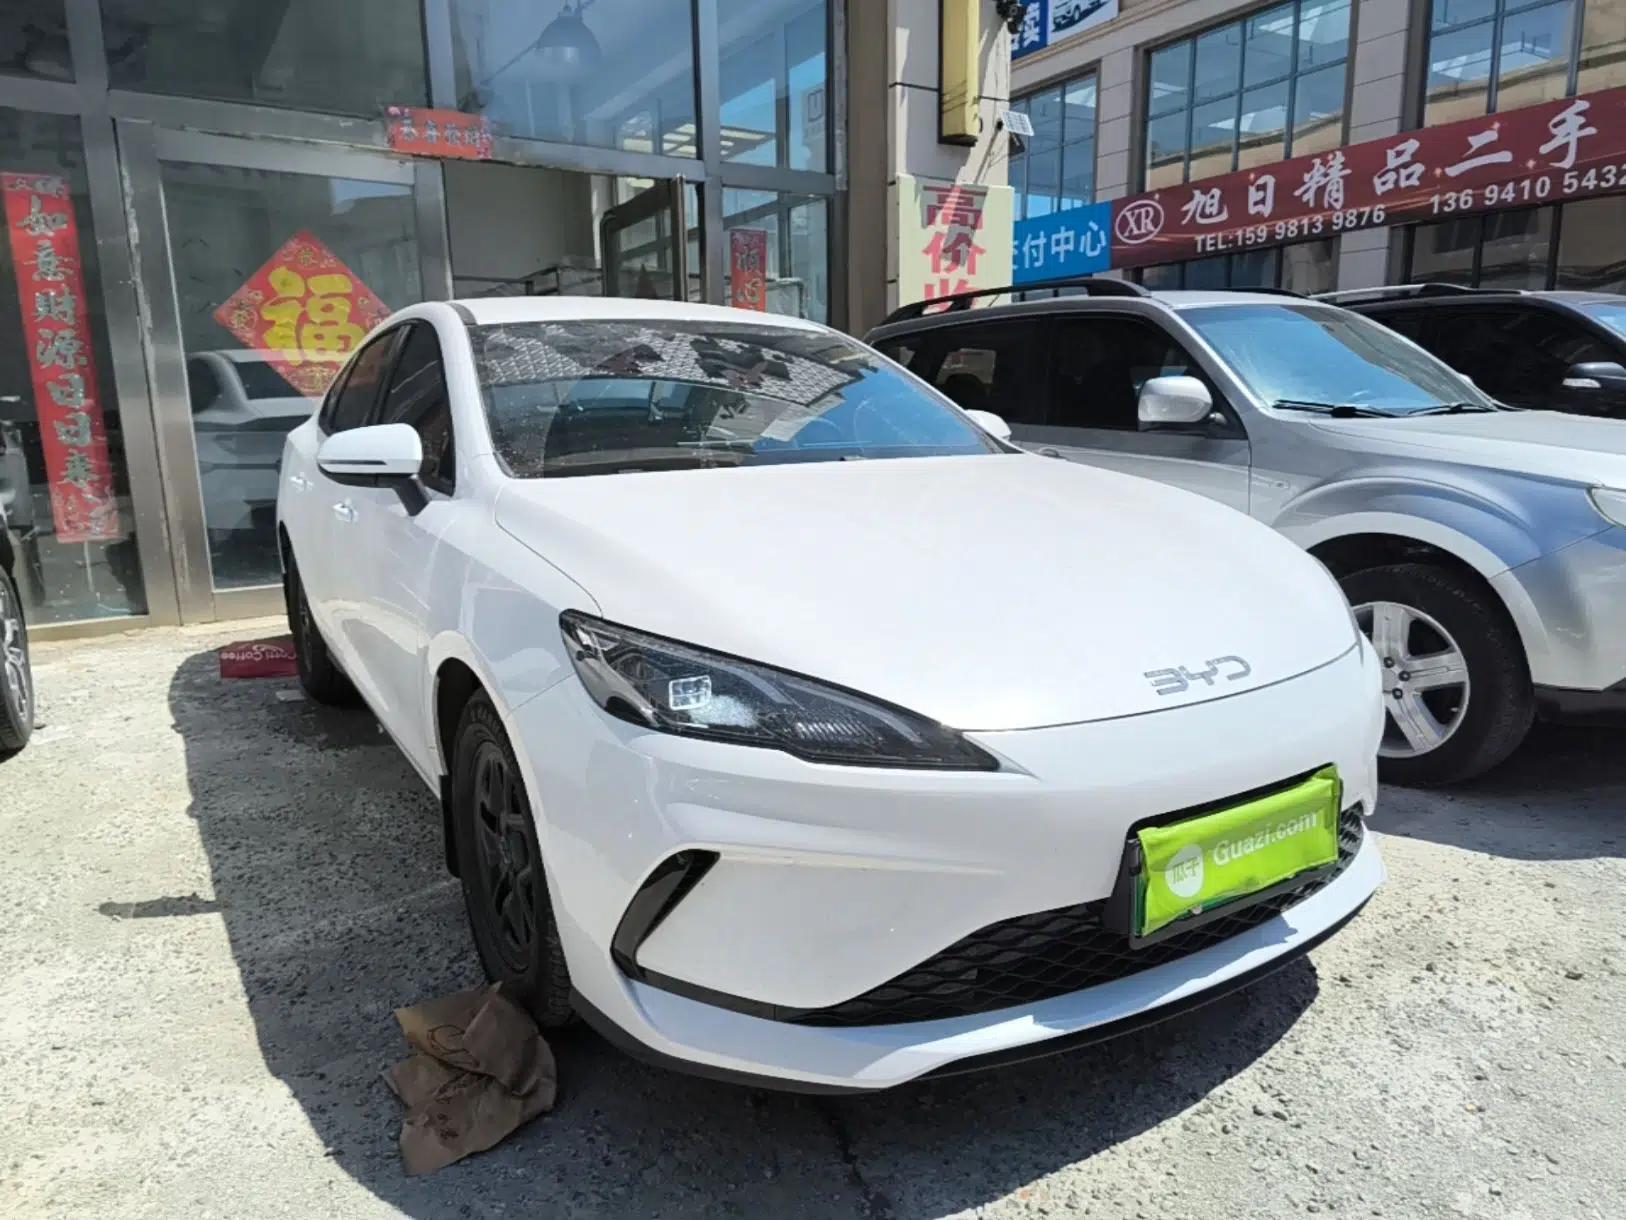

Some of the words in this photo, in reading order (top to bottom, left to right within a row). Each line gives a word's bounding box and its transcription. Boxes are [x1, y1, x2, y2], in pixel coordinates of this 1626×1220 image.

[1181, 100, 1597, 224] 旭日精品二手
[1122, 205, 1156, 237] XR
[1194, 227, 1267, 253] TEL:159
[1275, 215, 1323, 241] 9813
[1332, 204, 1386, 231] 9876
[1431, 188, 1474, 215] 136
[1484, 176, 1551, 206] 9410
[260, 265, 366, 366] 福
[1144, 655, 1251, 696] BYD
[1212, 812, 1318, 867] Guazi.com
